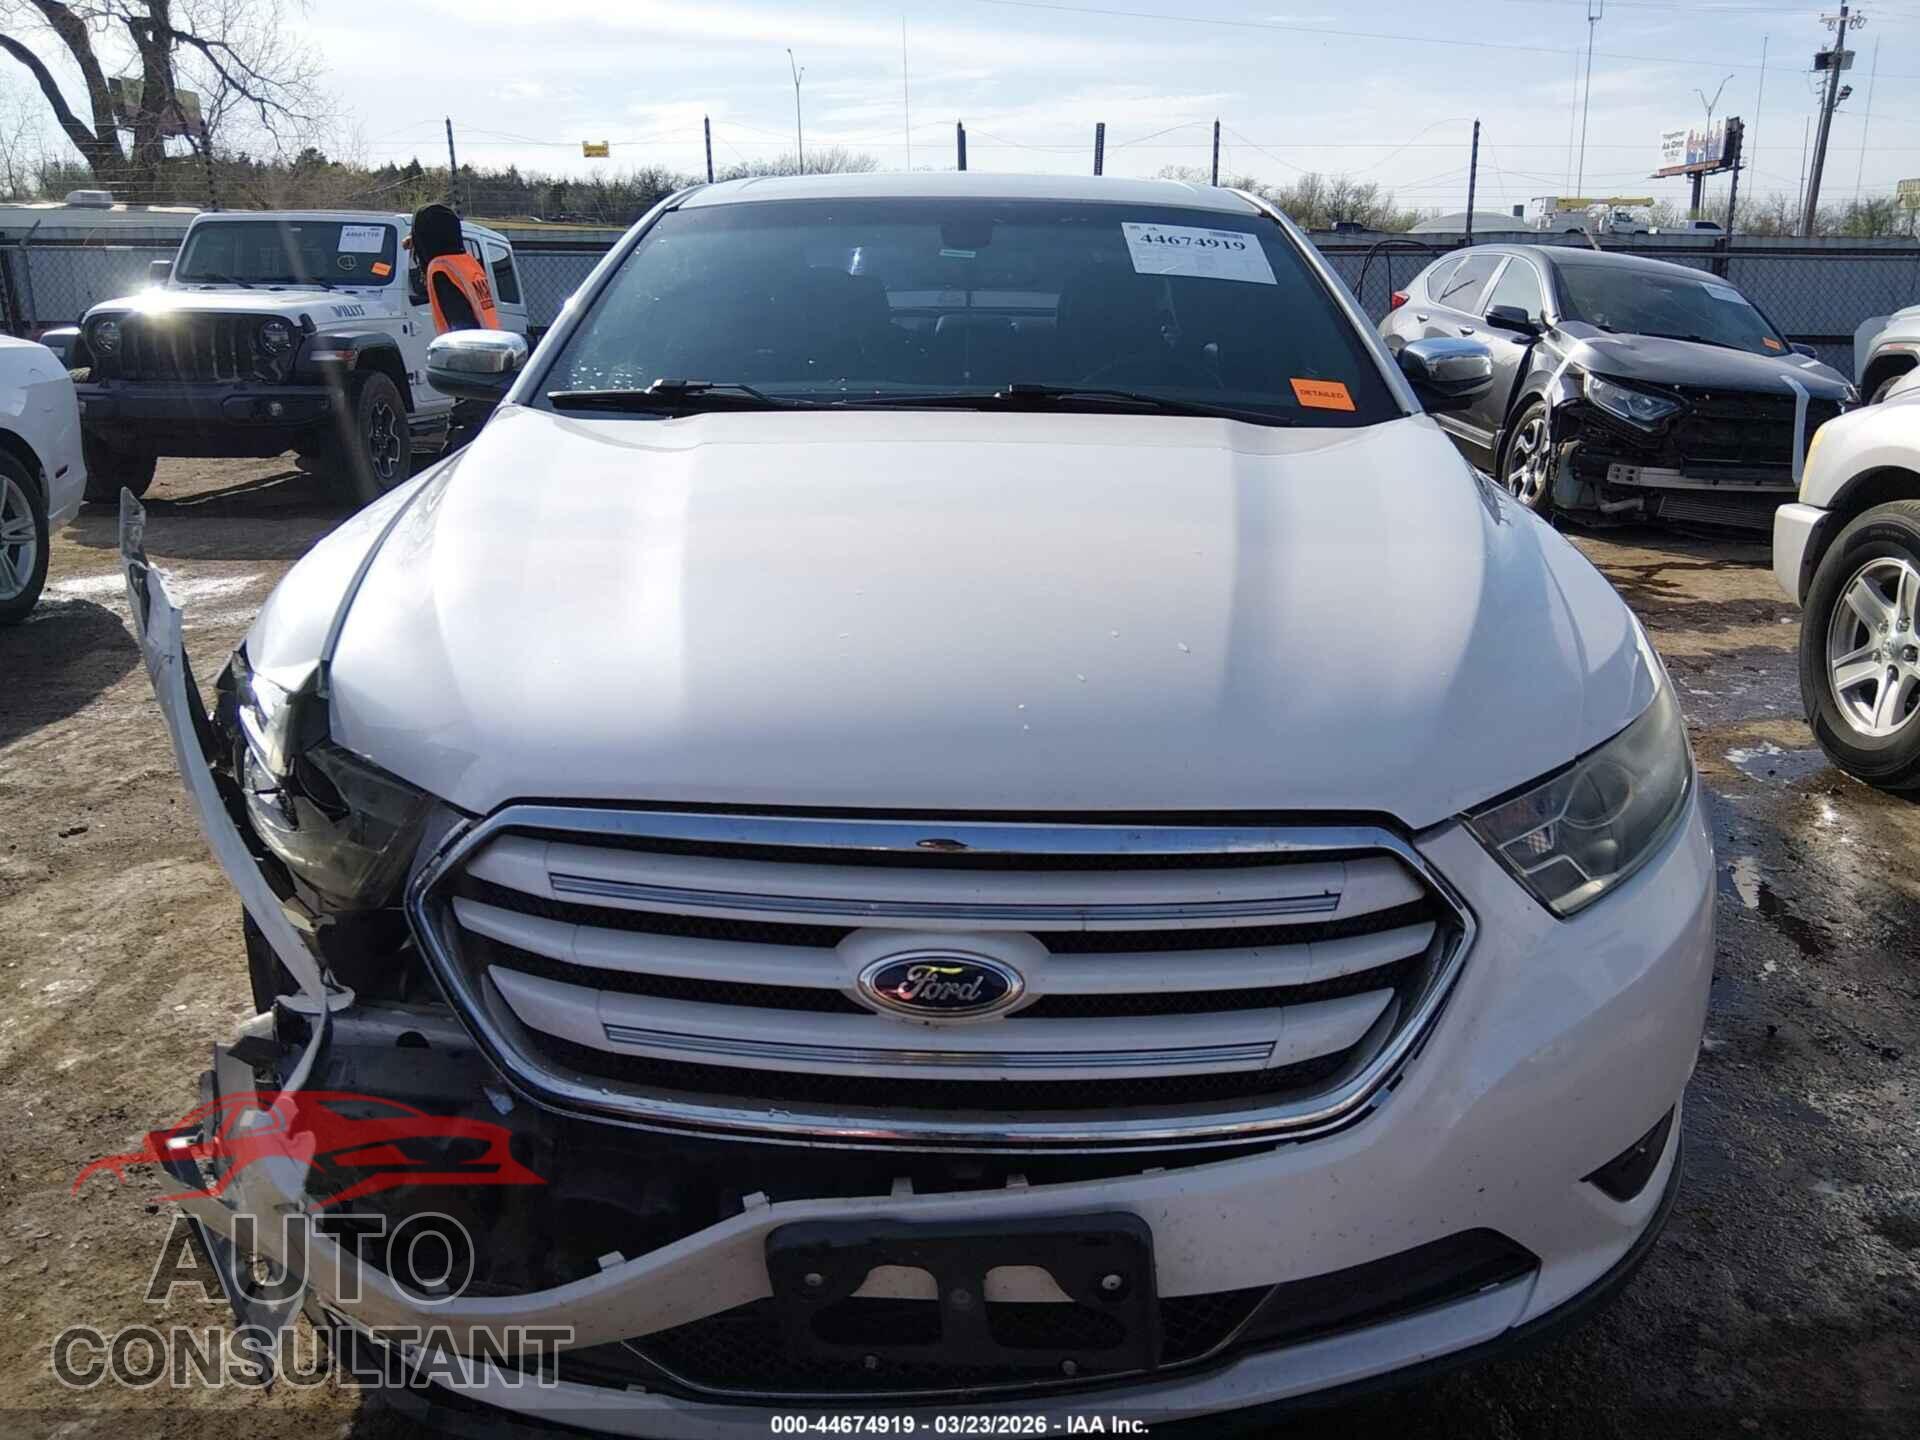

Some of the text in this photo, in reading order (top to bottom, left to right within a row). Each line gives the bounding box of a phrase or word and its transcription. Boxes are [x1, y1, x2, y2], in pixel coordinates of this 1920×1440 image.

[1141, 233, 1246, 251] 44674919
[1299, 389, 1344, 399] DETAILED
[898, 964, 984, 1001] Ford
